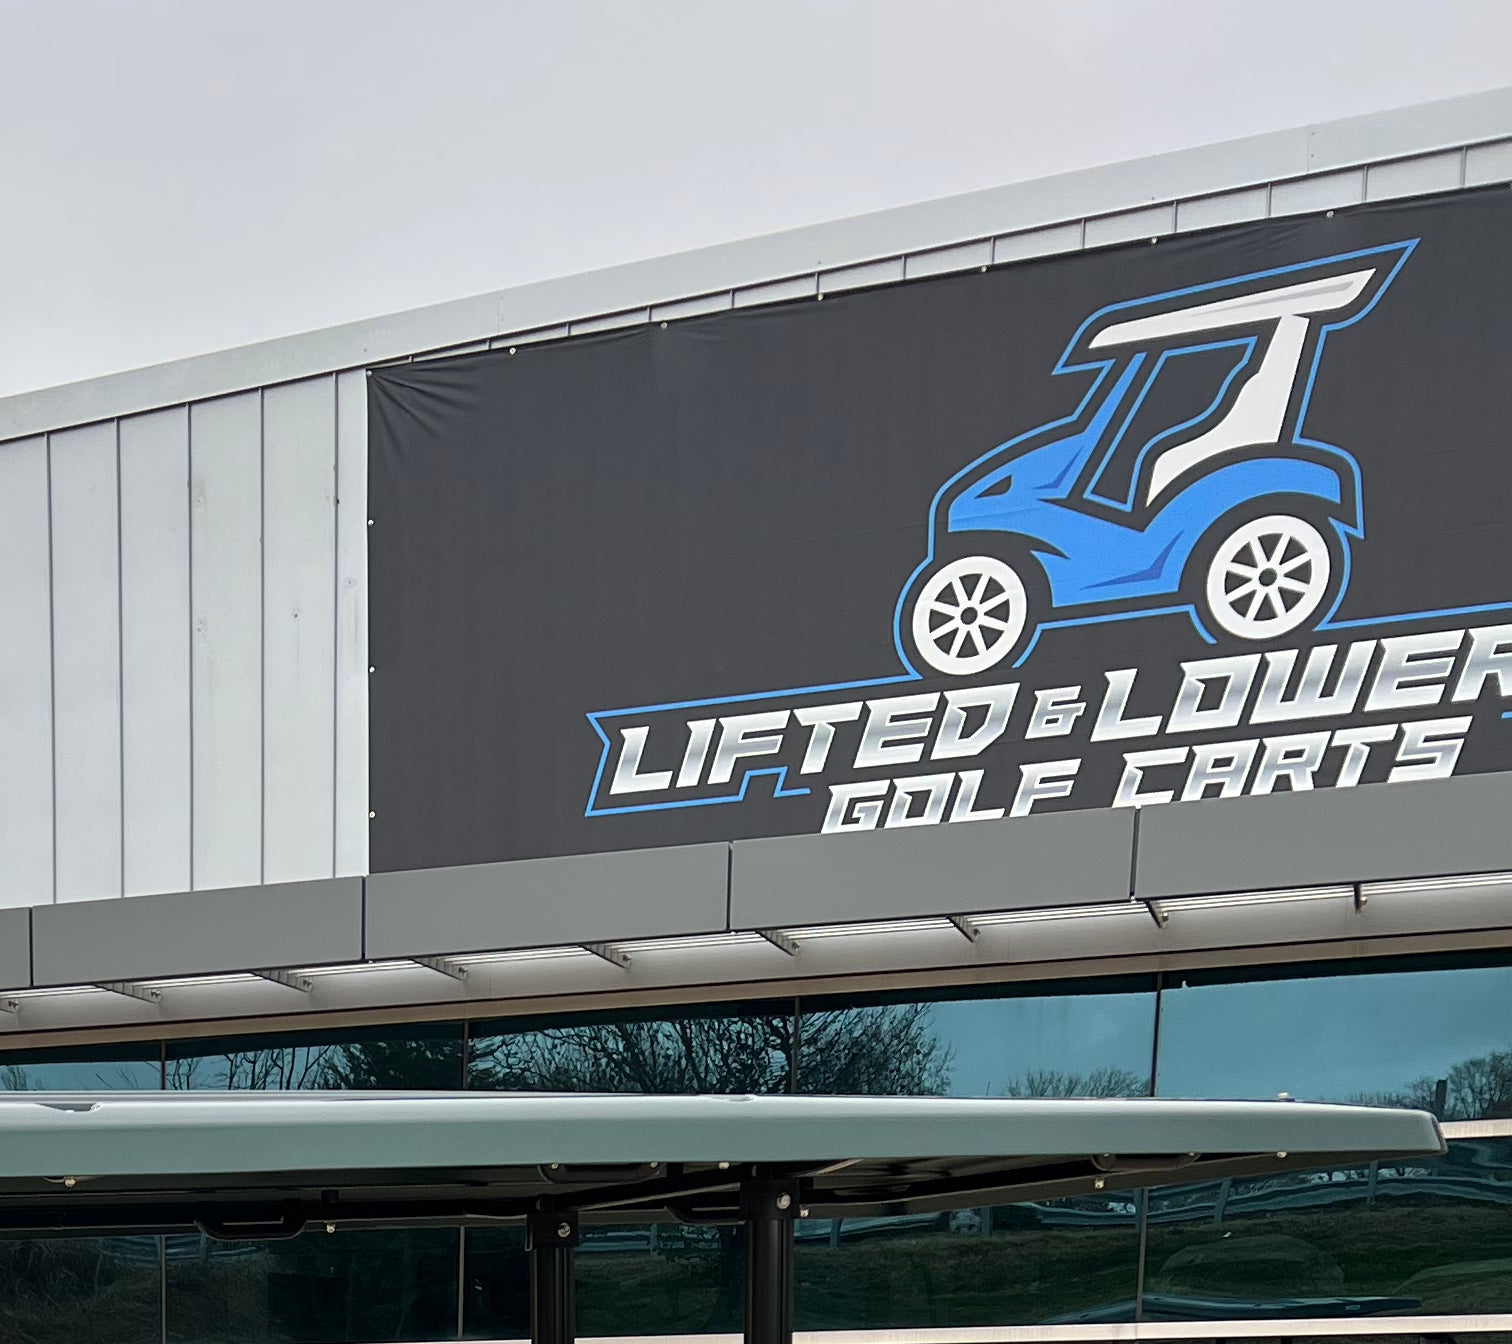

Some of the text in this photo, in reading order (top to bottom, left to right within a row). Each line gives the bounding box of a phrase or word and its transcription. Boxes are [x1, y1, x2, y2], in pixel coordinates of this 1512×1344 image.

[609, 682, 1021, 796] LIFTED
[1024, 685, 1087, 741] &
[820, 715, 1474, 835] GOLF CARTS
